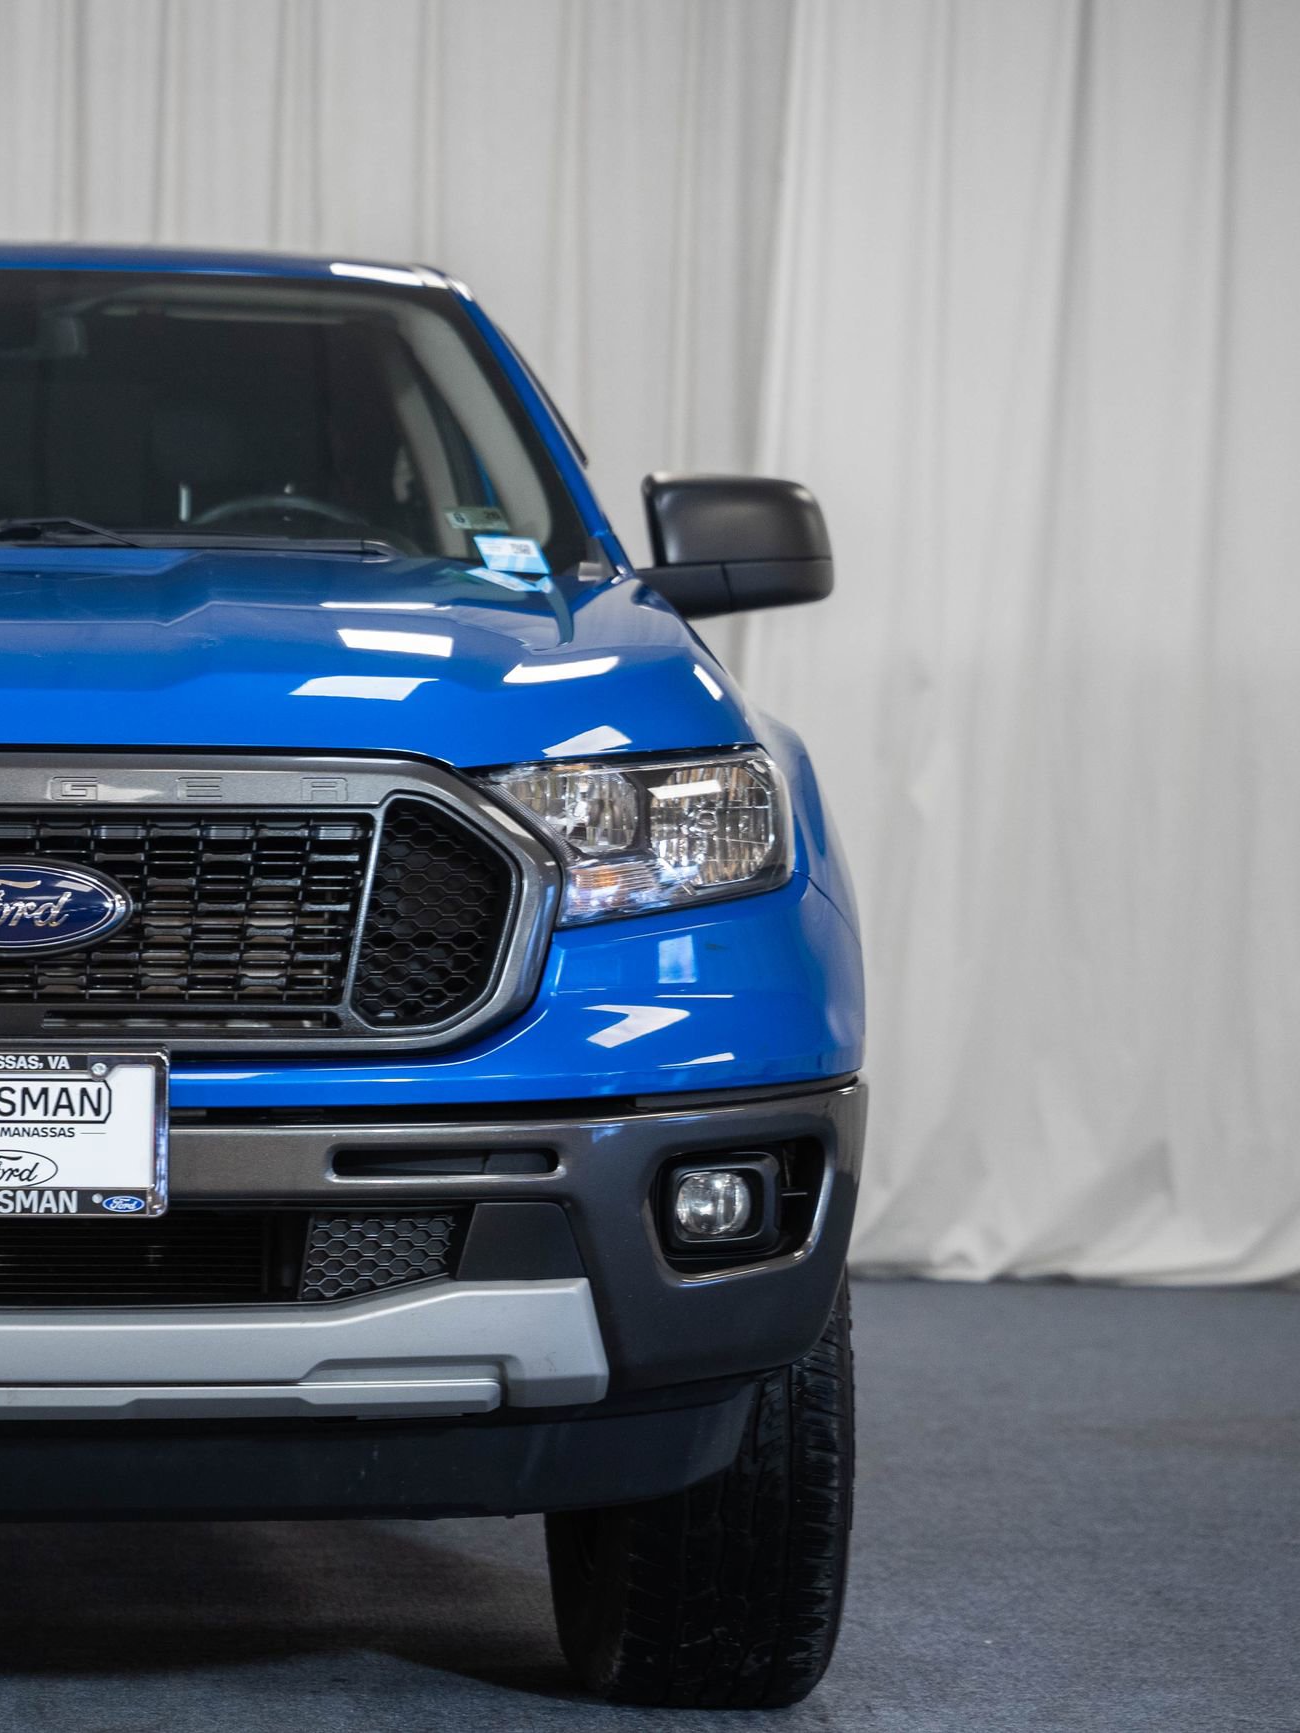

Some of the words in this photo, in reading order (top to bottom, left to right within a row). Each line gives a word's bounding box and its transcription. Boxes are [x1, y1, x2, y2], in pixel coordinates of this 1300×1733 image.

[48, 1056, 71, 1070] VA
[0, 1127, 76, 1138] MANASSAS
[109, 1198, 138, 1210] Ford
